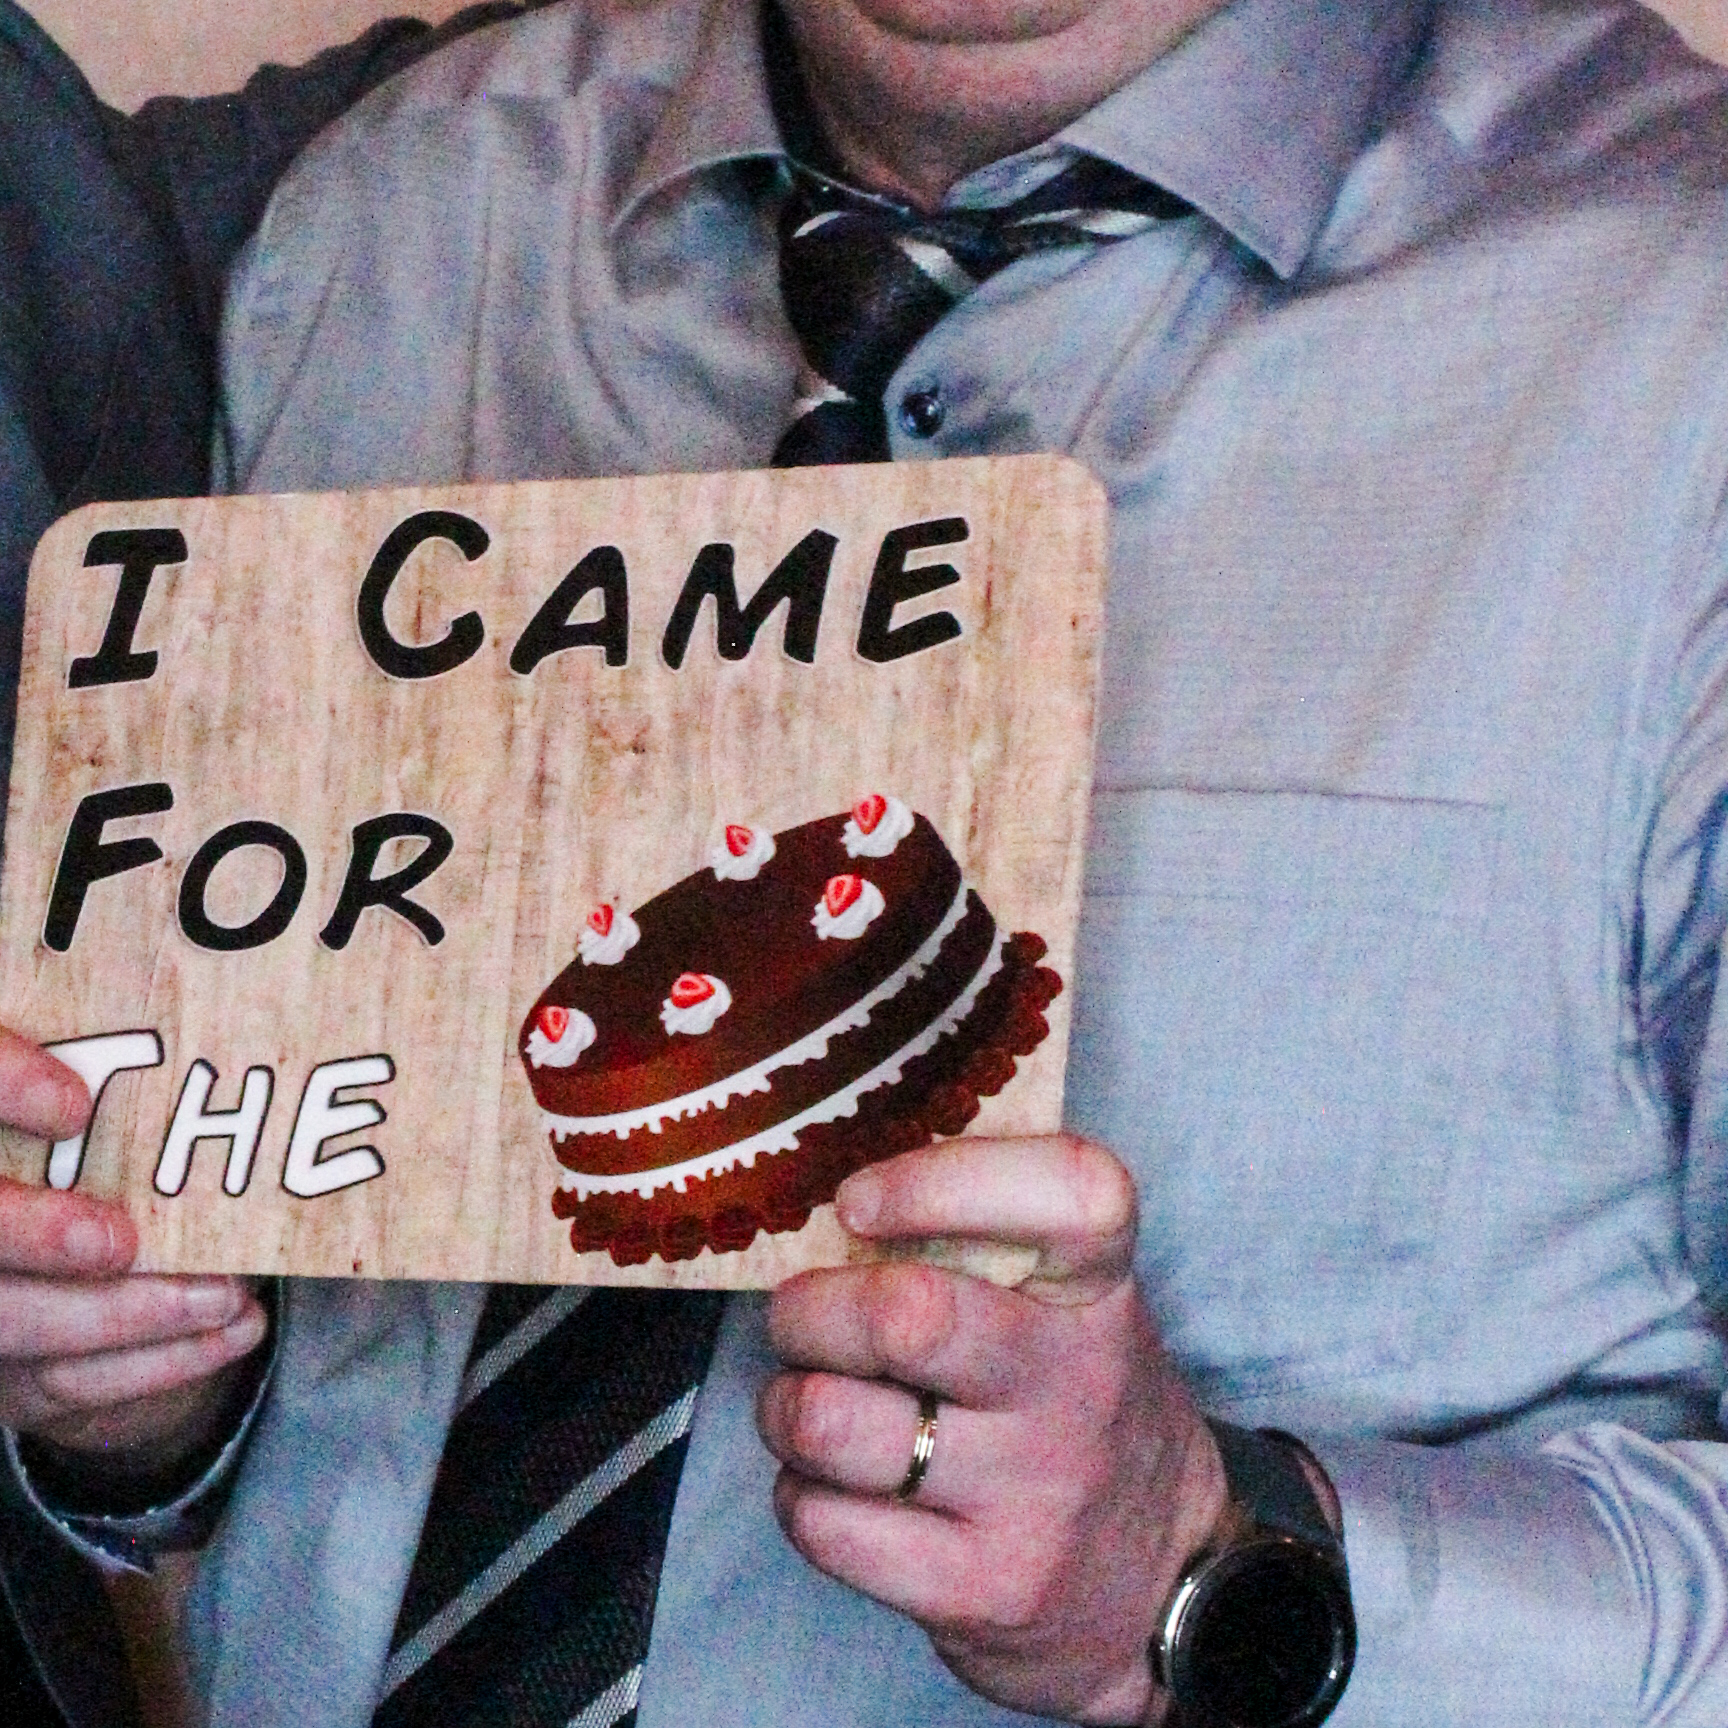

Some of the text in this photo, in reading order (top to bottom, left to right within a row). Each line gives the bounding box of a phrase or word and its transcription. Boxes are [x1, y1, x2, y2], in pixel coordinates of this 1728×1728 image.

[70, 511, 971, 688] I CAME
[43, 782, 455, 952] FOR
[38, 1028, 396, 1199] THE
